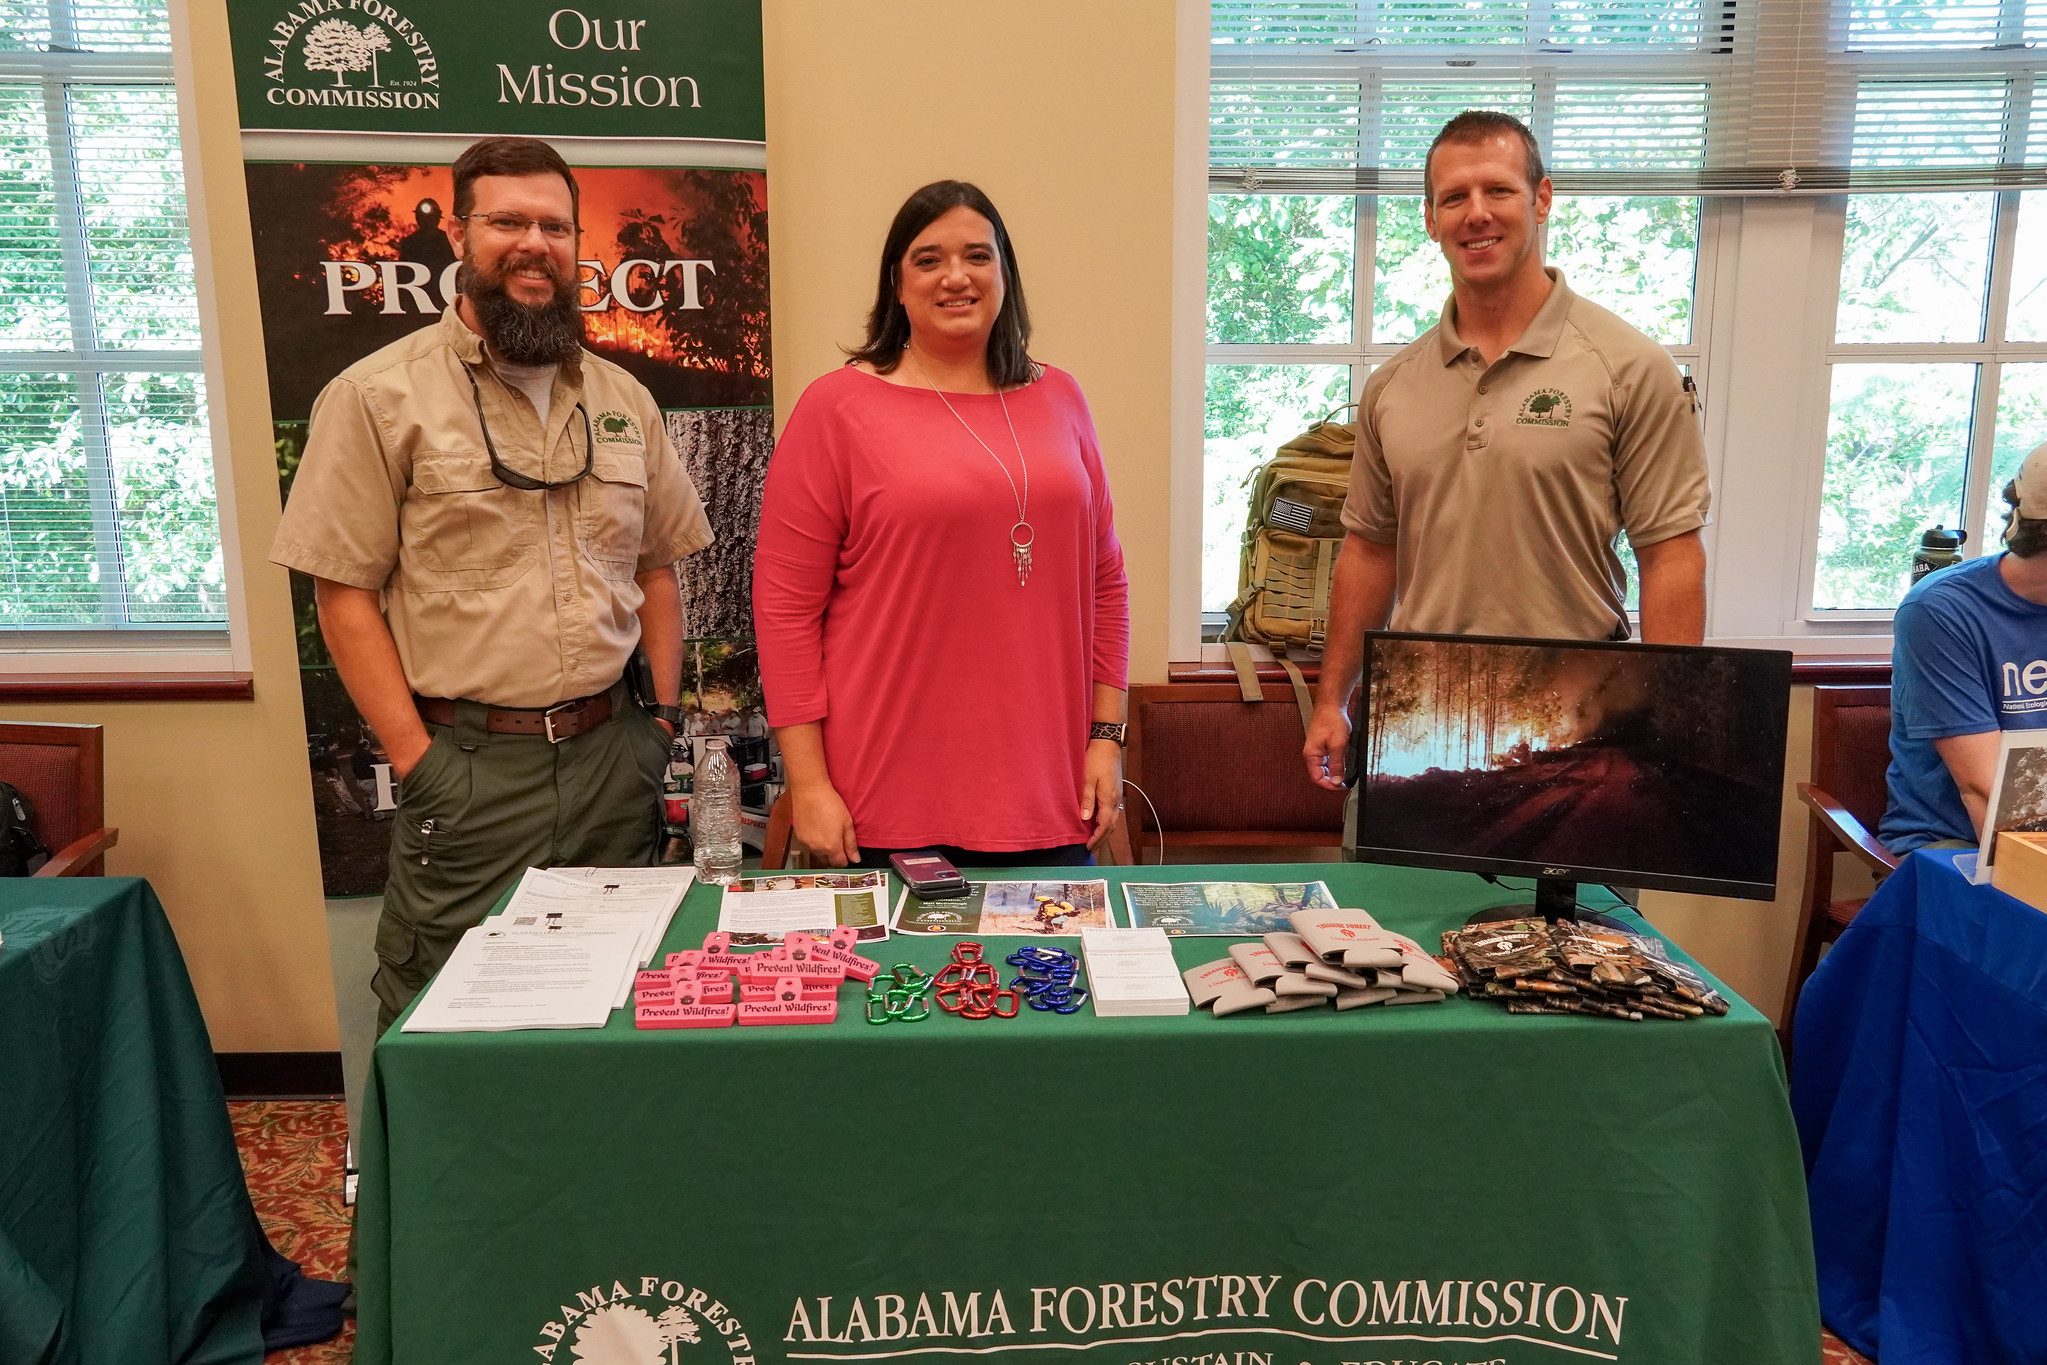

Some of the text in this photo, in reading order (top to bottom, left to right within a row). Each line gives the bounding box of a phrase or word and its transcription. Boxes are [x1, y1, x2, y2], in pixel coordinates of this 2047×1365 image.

[548, 8, 647, 51] Our
[264, 0, 344, 84] ALABAMA
[496, 63, 702, 108] Mission
[266, 87, 440, 110] COMMISSION
[320, 258, 716, 315] PRECT
[1519, 388, 1572, 420] ALABAMA FORESTRY
[593, 411, 641, 440] ALABAMA FORESTRY
[1516, 418, 1570, 427] COMMISSION
[596, 437, 643, 447] COMMISSION
[1543, 867, 1570, 876] acer
[708, 956, 751, 965] Wildfires!
[757, 962, 793, 973] Prevent
[796, 963, 841, 975] Wildfires!
[812, 945, 874, 971] vent Wildfires!
[697, 971, 723, 980] fires!
[703, 984, 728, 994] fires!
[642, 1006, 730, 1017] Prevent Wildfires!
[744, 1003, 831, 1013] Prevent Wildfires!
[533, 1276, 756, 1365] ABAMA FOREST
[783, 1275, 1629, 1346] ALABAMA FORESTRY COMMISSION
